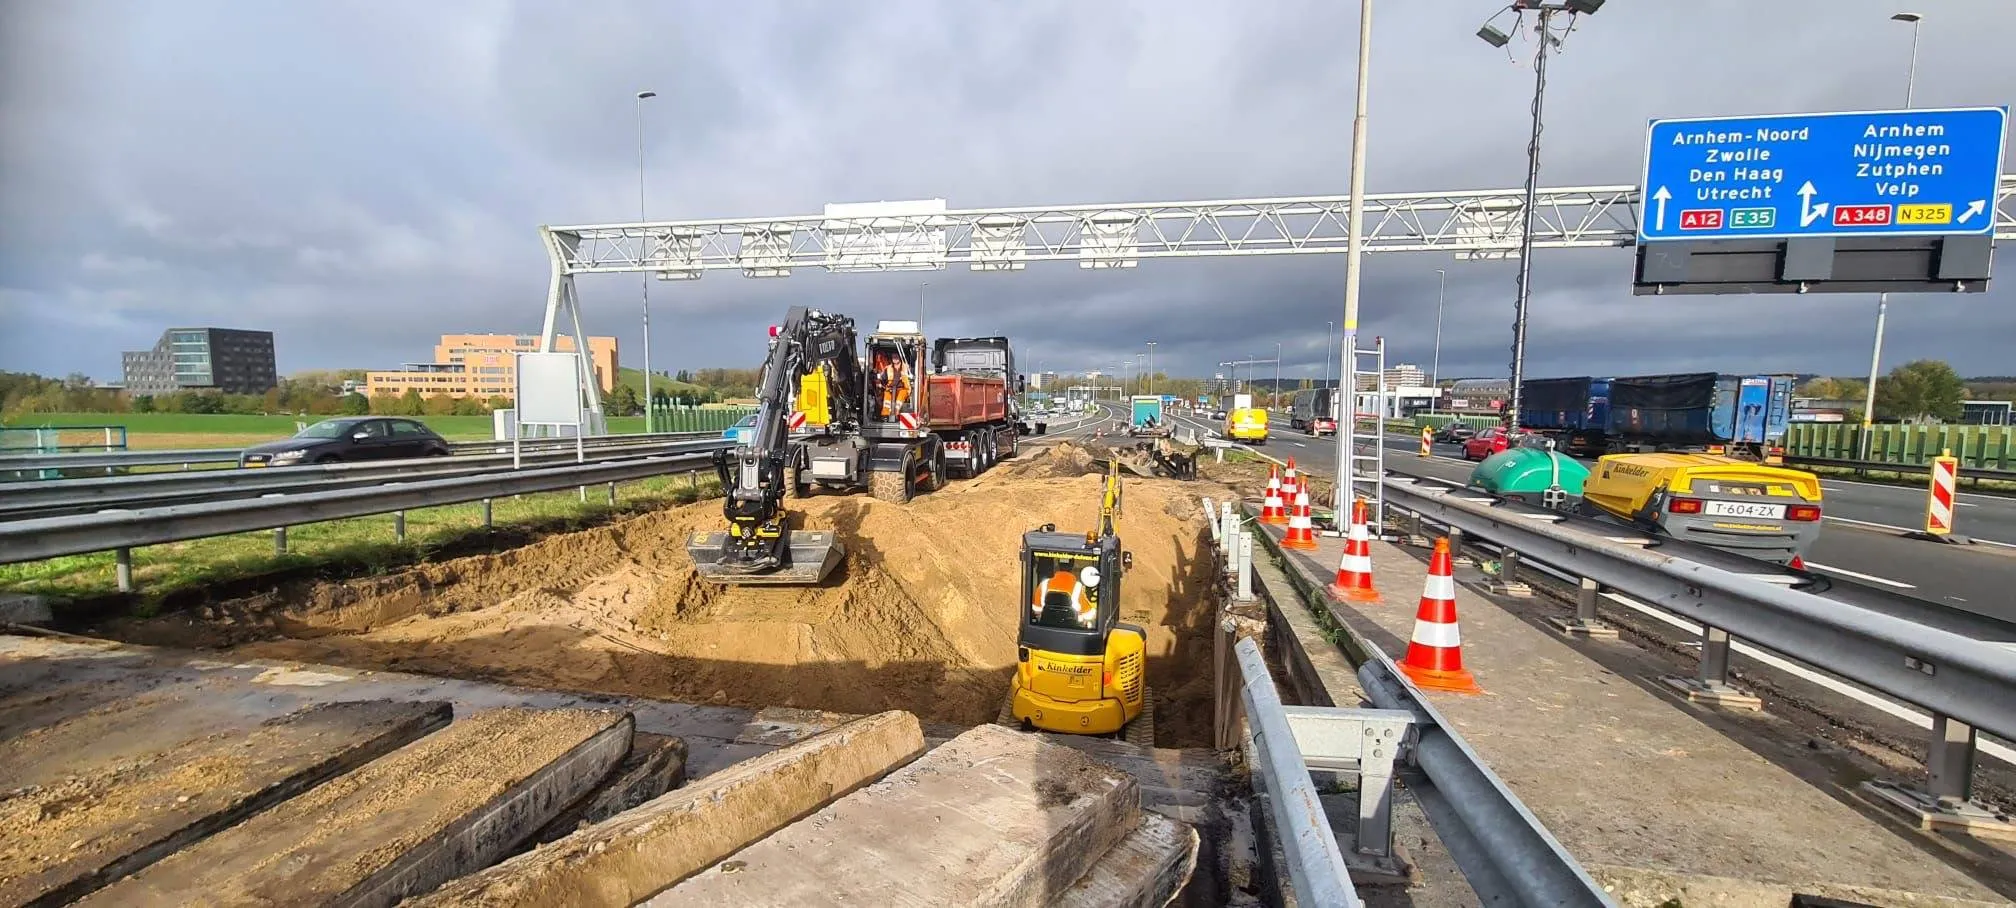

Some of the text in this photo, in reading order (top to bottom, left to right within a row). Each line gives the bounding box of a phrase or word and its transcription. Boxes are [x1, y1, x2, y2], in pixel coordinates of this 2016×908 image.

[1672, 126, 1809, 145] Arnhem-Noord
[1863, 124, 1945, 138] Arnhem
[1706, 148, 1771, 163] Zwolle
[1853, 143, 1951, 161] Nijmegen
[1689, 167, 1784, 184] Den Haag
[1856, 162, 1944, 179] Zutphen
[1697, 186, 1773, 201] Utrecht
[1876, 181, 1920, 198] Velp
[1685, 213, 1719, 226] A 12
[1734, 211, 1770, 225] E 35
[1839, 208, 1887, 222] A 348
[1901, 208, 1946, 220] N 325
[1613, 463, 1649, 477] Kinkelder
[1715, 503, 1776, 517] T-604-ZX
[1047, 662, 1093, 674] Kinkelder
